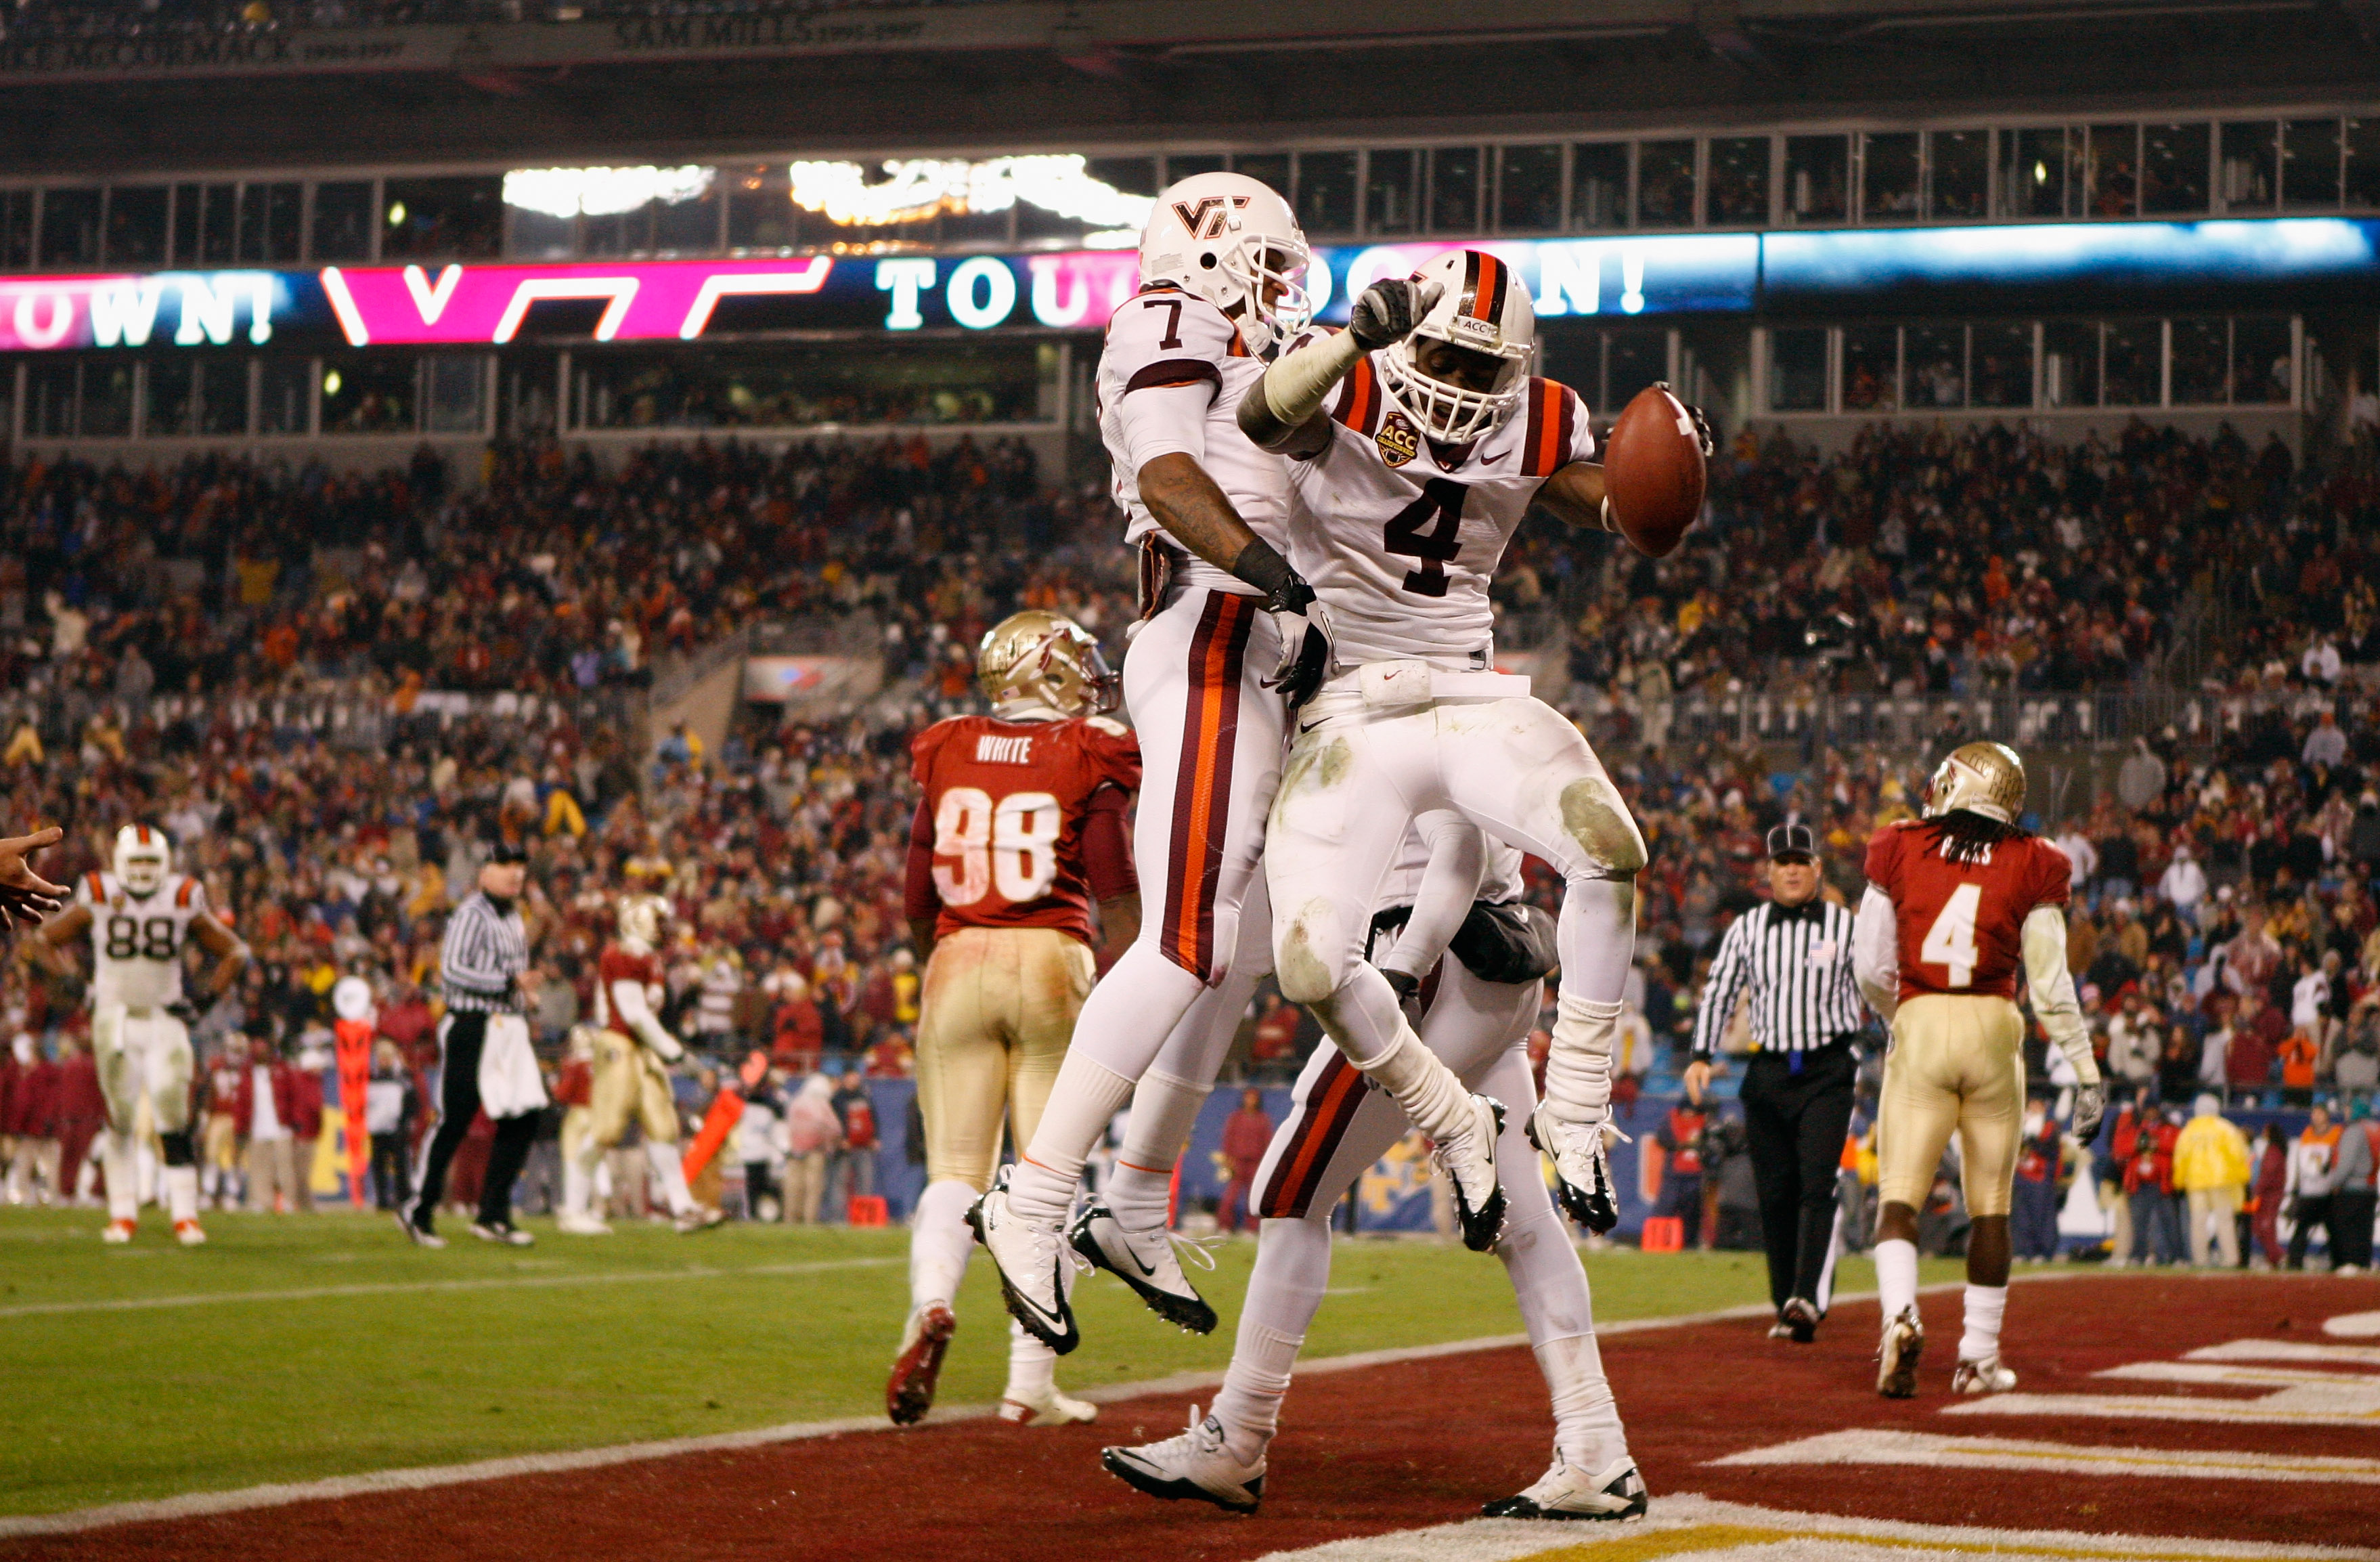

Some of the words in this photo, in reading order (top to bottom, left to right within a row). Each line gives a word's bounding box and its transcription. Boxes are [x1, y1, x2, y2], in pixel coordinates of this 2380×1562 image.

[615, 18, 690, 49] SAM
[704, 15, 812, 47] MILLS
[1172, 196, 1251, 240] VT
[1143, 300, 1183, 351] 7
[1463, 320, 1489, 334] ACC
[1381, 425, 1418, 450] ACC
[1384, 477, 1470, 597] 4
[976, 735, 1033, 764] WHITE
[932, 787, 1061, 907] 98
[106, 916, 176, 962] 88
[1920, 882, 1982, 988] 4
